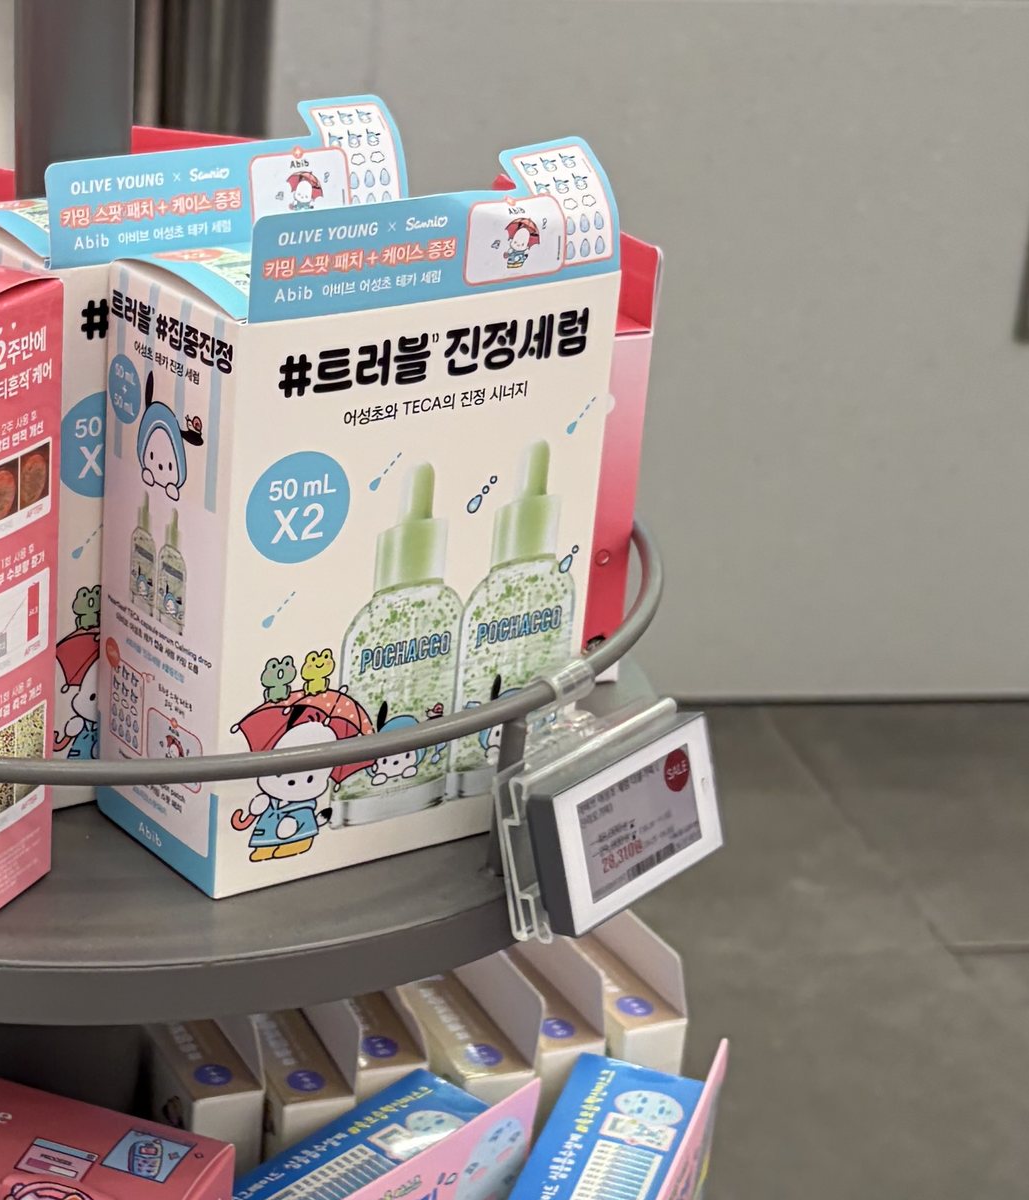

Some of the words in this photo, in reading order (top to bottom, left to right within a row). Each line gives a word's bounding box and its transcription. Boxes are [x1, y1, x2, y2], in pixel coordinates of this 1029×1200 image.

[290, 158, 310, 169] Abib
[70, 178, 113, 195] OLIVE
[117, 172, 164, 189] YOUNG
[61, 208, 91, 228] 카밍
[94, 204, 123, 223] 스팟
[126, 201, 154, 219] 패치
[172, 195, 212, 216] 케이스
[215, 192, 241, 209] 증정
[74, 234, 109, 250] Abib
[118, 228, 149, 245] 아비브
[153, 225, 184, 242] 어성초
[278, 228, 322, 246] OLIVE
[327, 221, 378, 241] YOUNG
[264, 256, 294, 276] 카밍
[299, 255, 330, 274] 스팟
[333, 250, 364, 269] 패치
[381, 244, 424, 266] 케이스
[428, 240, 456, 258] 증정
[275, 286, 312, 303] Abib
[322, 281, 355, 297] 아비브
[359, 276, 391, 292] 어성초
[156, 313, 233, 375] #집중진정
[444, 308, 590, 378] 진정세럼
[33, 359, 52, 384] 케어
[344, 402, 398, 427] 어성초와
[403, 395, 456, 415] TECA의
[460, 390, 486, 408] 진정
[490, 381, 528, 402] 시너지
[75, 417, 102, 439] 50
[269, 478, 297, 502] 50
[303, 473, 336, 497] mL
[271, 503, 324, 544] X2
[475, 605, 562, 648] POCHACCO
[360, 631, 452, 673] POCHACCO
[667, 761, 689, 779] SALE
